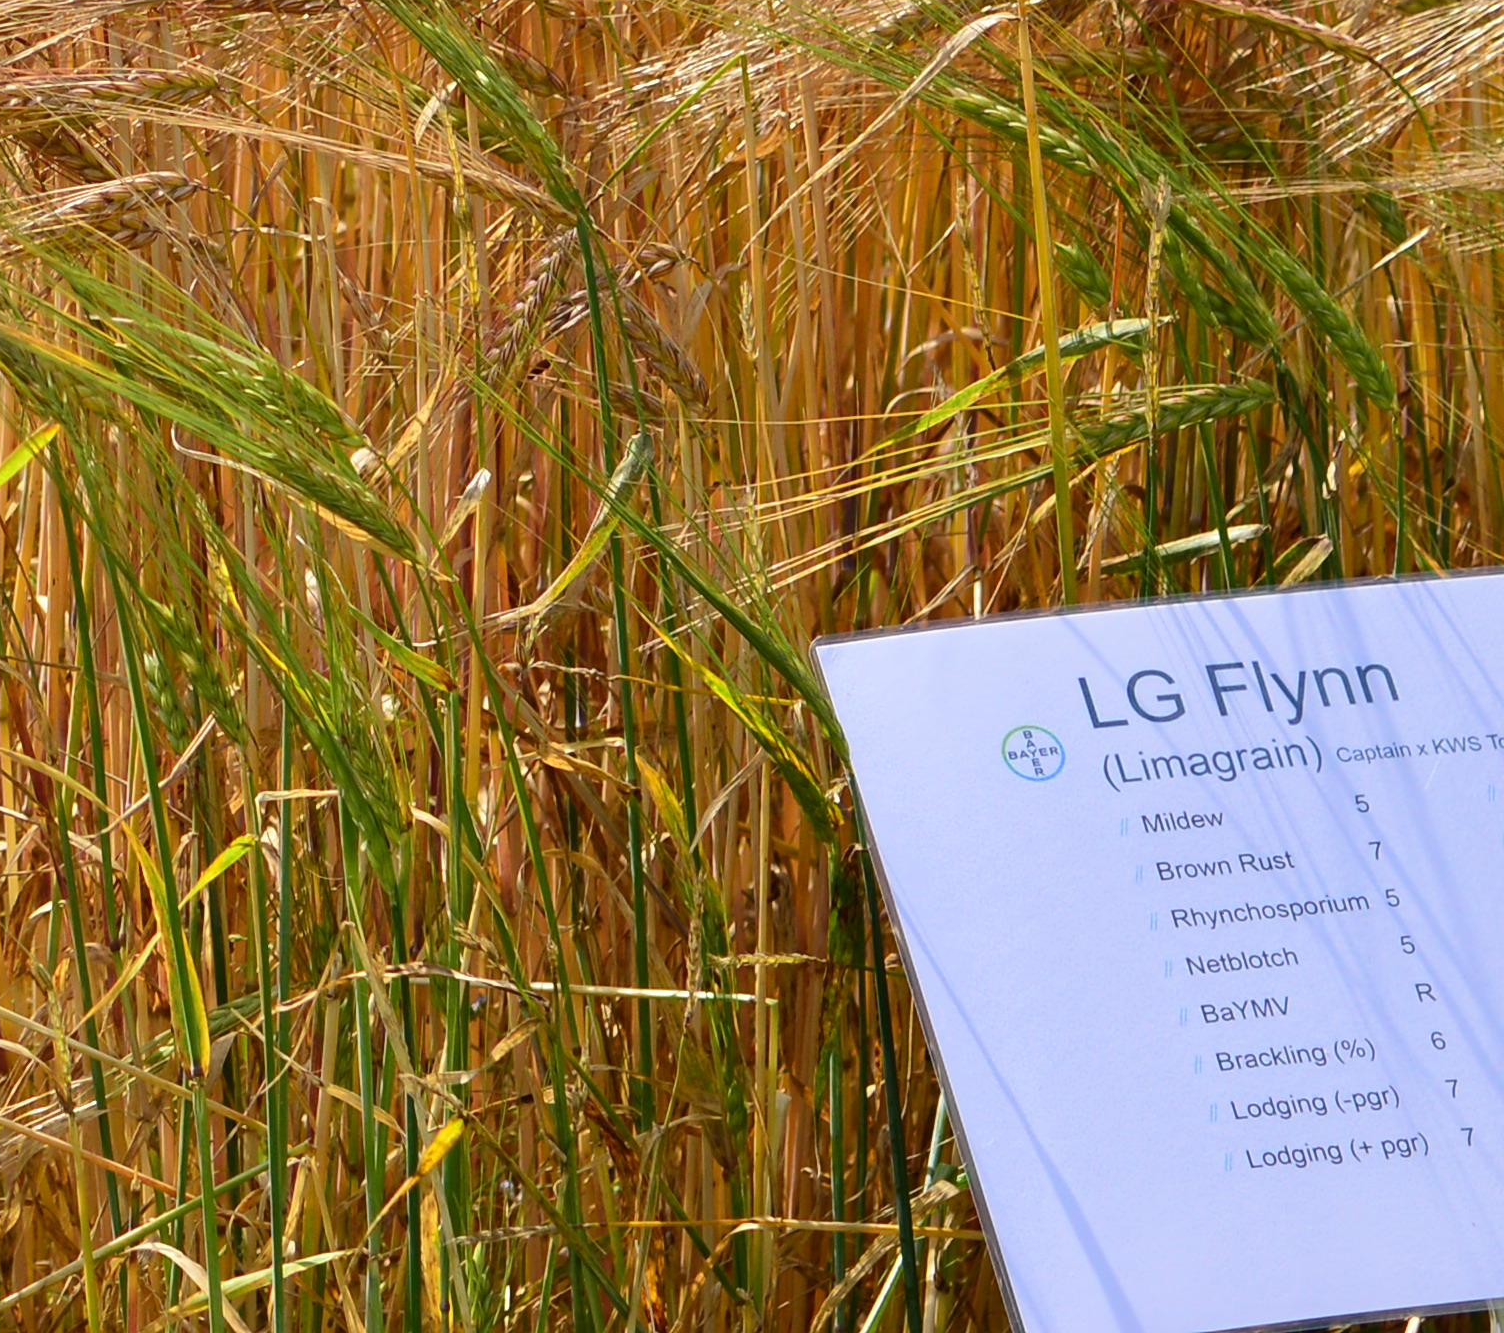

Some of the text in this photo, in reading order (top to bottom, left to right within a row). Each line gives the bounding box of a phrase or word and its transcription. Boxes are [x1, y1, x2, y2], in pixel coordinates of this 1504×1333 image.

[1078, 660, 1399, 729] LG Flynn
[1008, 746, 1059, 760] BAYER
[1103, 735, 1322, 793] (Limagrain)
[1336, 742, 1412, 764] Captain
[1416, 743, 1429, 756] x
[1431, 735, 1482, 754] KWS
[1141, 794, 1370, 833] Mildew 5
[1156, 841, 1382, 881] Brown Rust 7
[1171, 888, 1400, 929] Rhynchosporium 5
[1185, 935, 1416, 976] Netblotch 5
[1200, 983, 1436, 1024] BaYMV R
[1215, 1031, 1446, 1071] Brackling (%) 6
[1230, 1079, 1458, 1120] Lodging (-pgr) 7
[1245, 1143, 1343, 1169] Lodging
[1380, 1132, 1429, 1160] pgr)
[1460, 1127, 1474, 1147] 7
